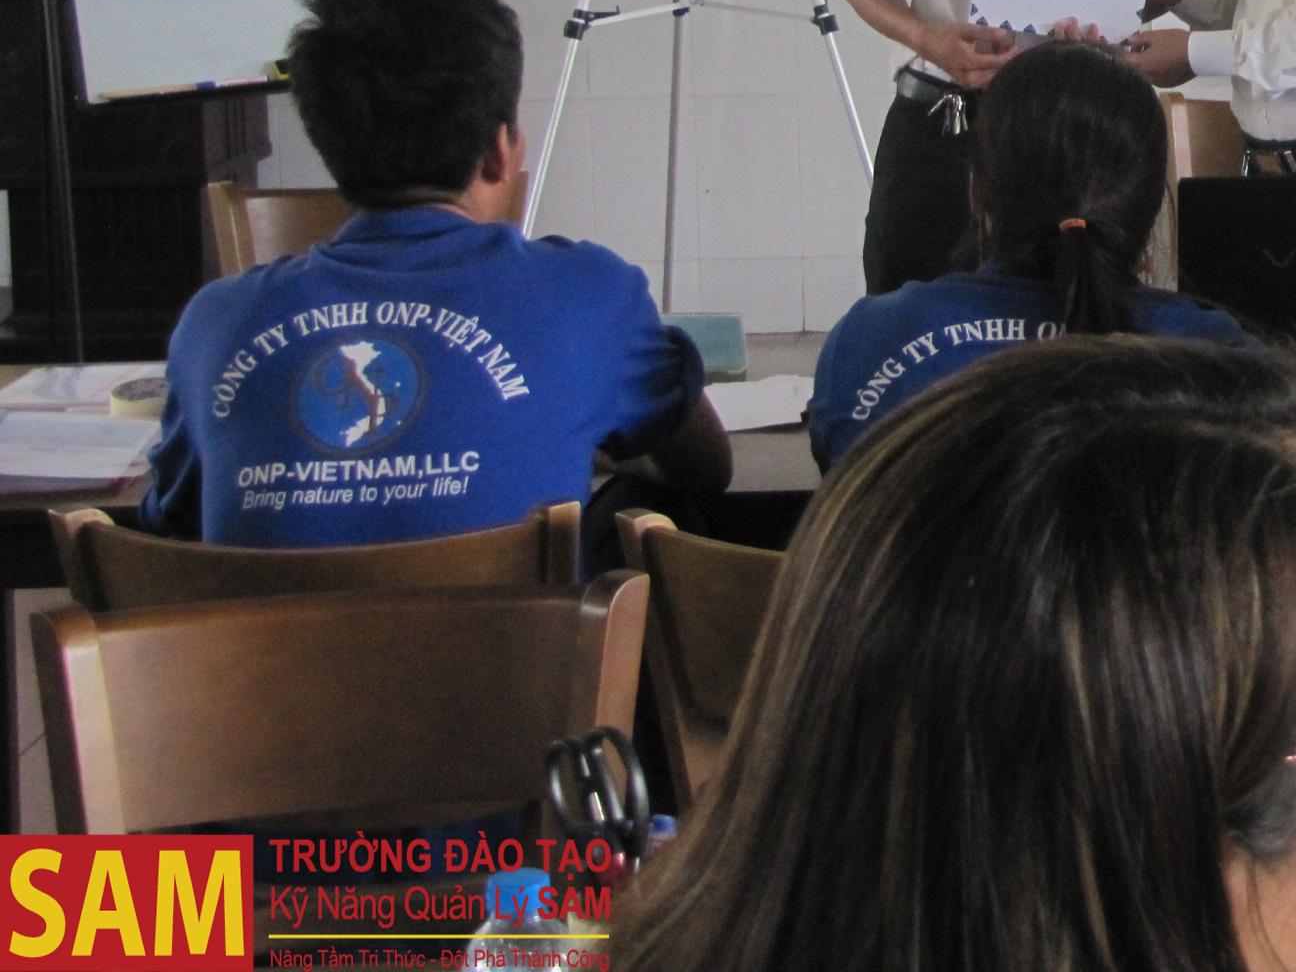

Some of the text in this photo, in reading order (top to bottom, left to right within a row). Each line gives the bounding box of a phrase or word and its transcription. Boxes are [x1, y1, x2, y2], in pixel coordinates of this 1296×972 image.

[213, 349, 258, 418] CÔNG
[253, 324, 290, 356] TY
[294, 301, 368, 337] TNHH
[477, 343, 530, 401] NAM
[851, 359, 906, 421] CÔNG
[902, 331, 940, 365] TY
[944, 318, 1027, 347] TNHH
[242, 476, 469, 510] Bring nature to your life!
